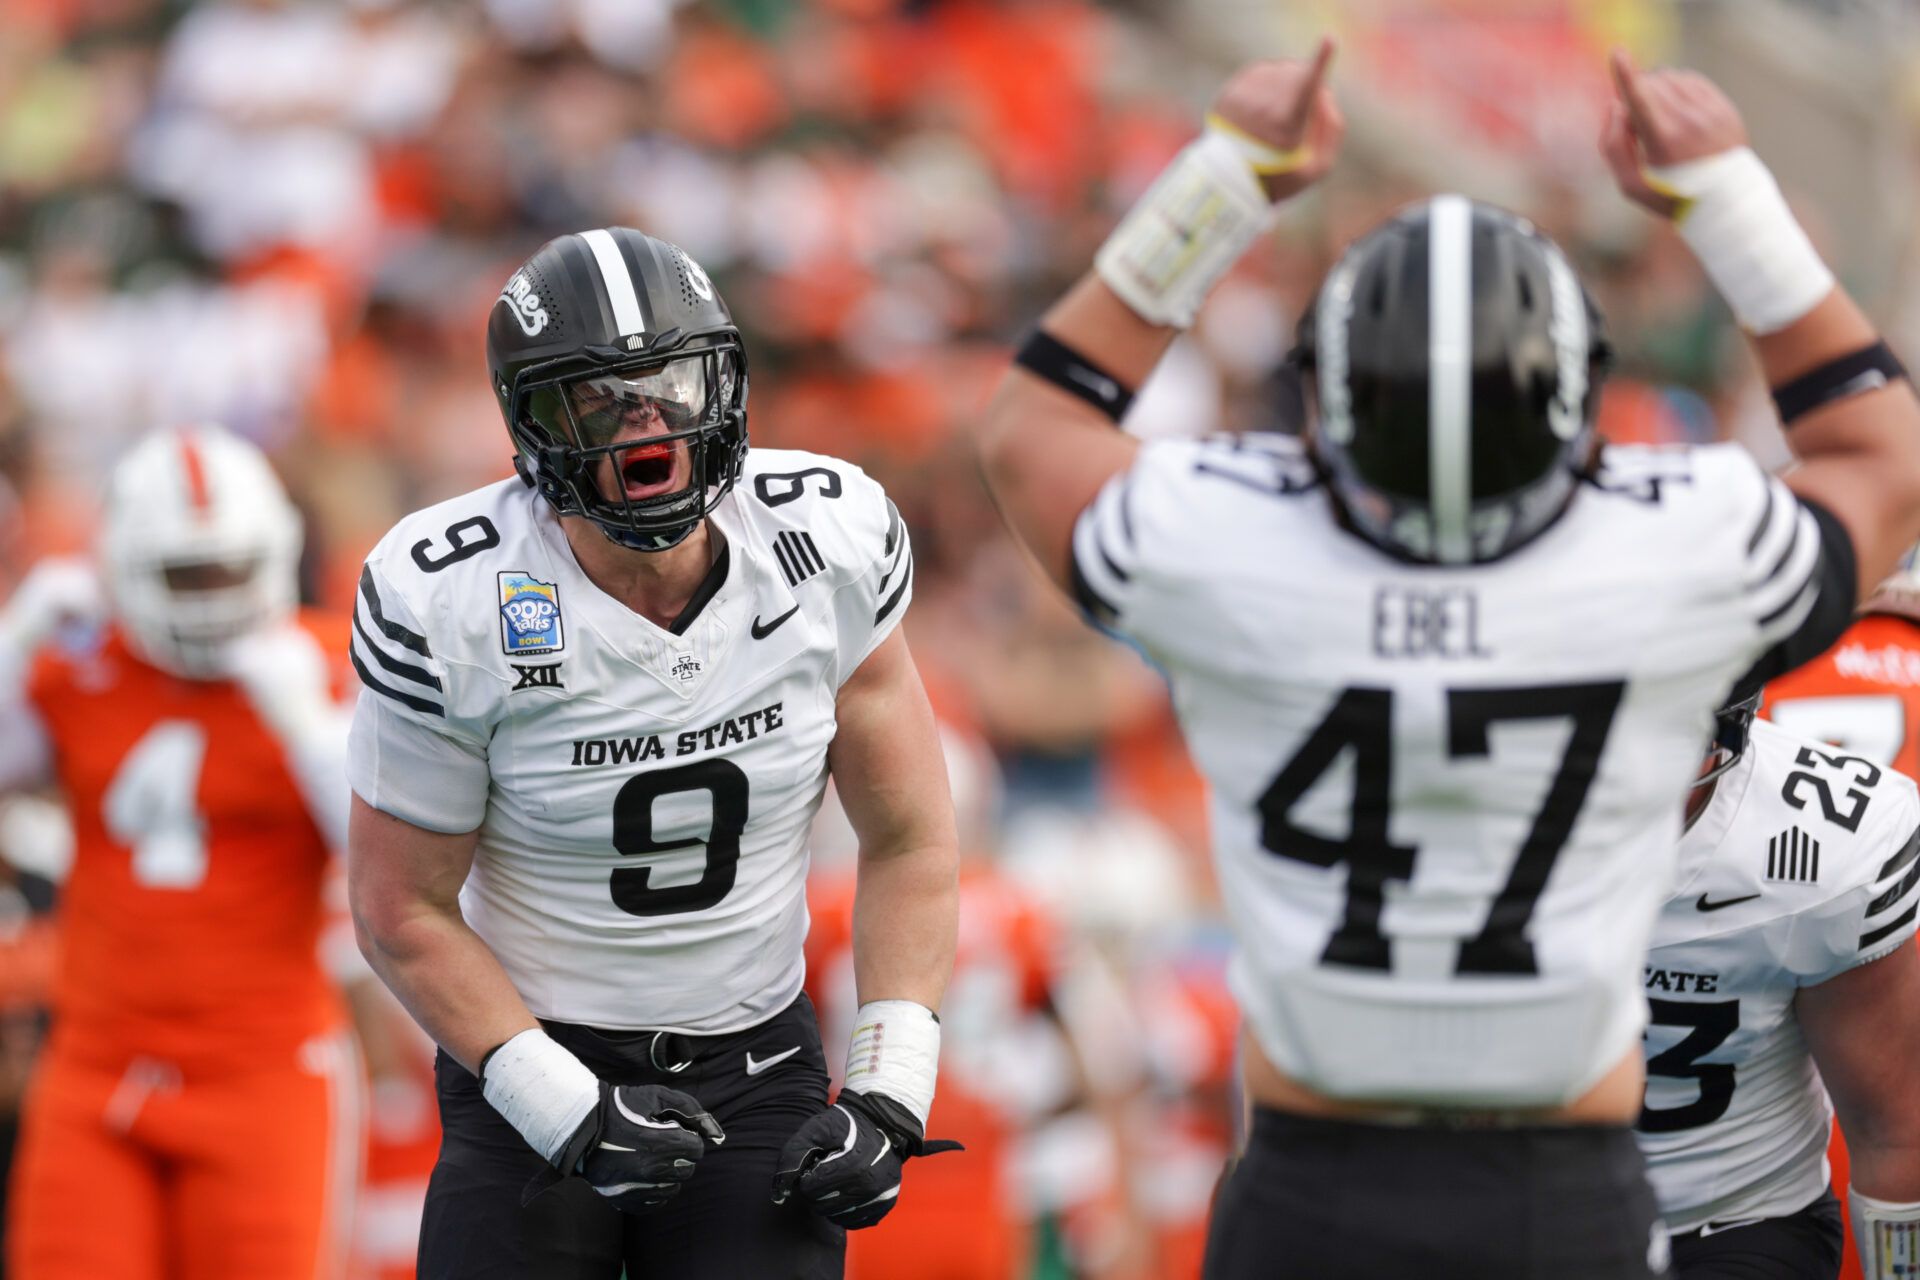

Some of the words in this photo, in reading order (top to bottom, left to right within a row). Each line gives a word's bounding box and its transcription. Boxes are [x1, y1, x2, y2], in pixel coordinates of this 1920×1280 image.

[754, 467, 842, 508] 9
[411, 516, 500, 573] 9
[518, 637, 547, 646] BOWL
[1372, 586, 1494, 660] EBEL
[510, 663, 565, 691] XII
[672, 662, 701, 676] STATE
[571, 735, 665, 766] IOWA
[676, 702, 783, 757] STATE
[103, 720, 208, 889] 4
[1781, 747, 1882, 834] 23
[609, 758, 749, 917] 9
[1255, 680, 1627, 976] 47
[1645, 968, 1719, 993] ATE
[1636, 998, 1740, 1133] 3
